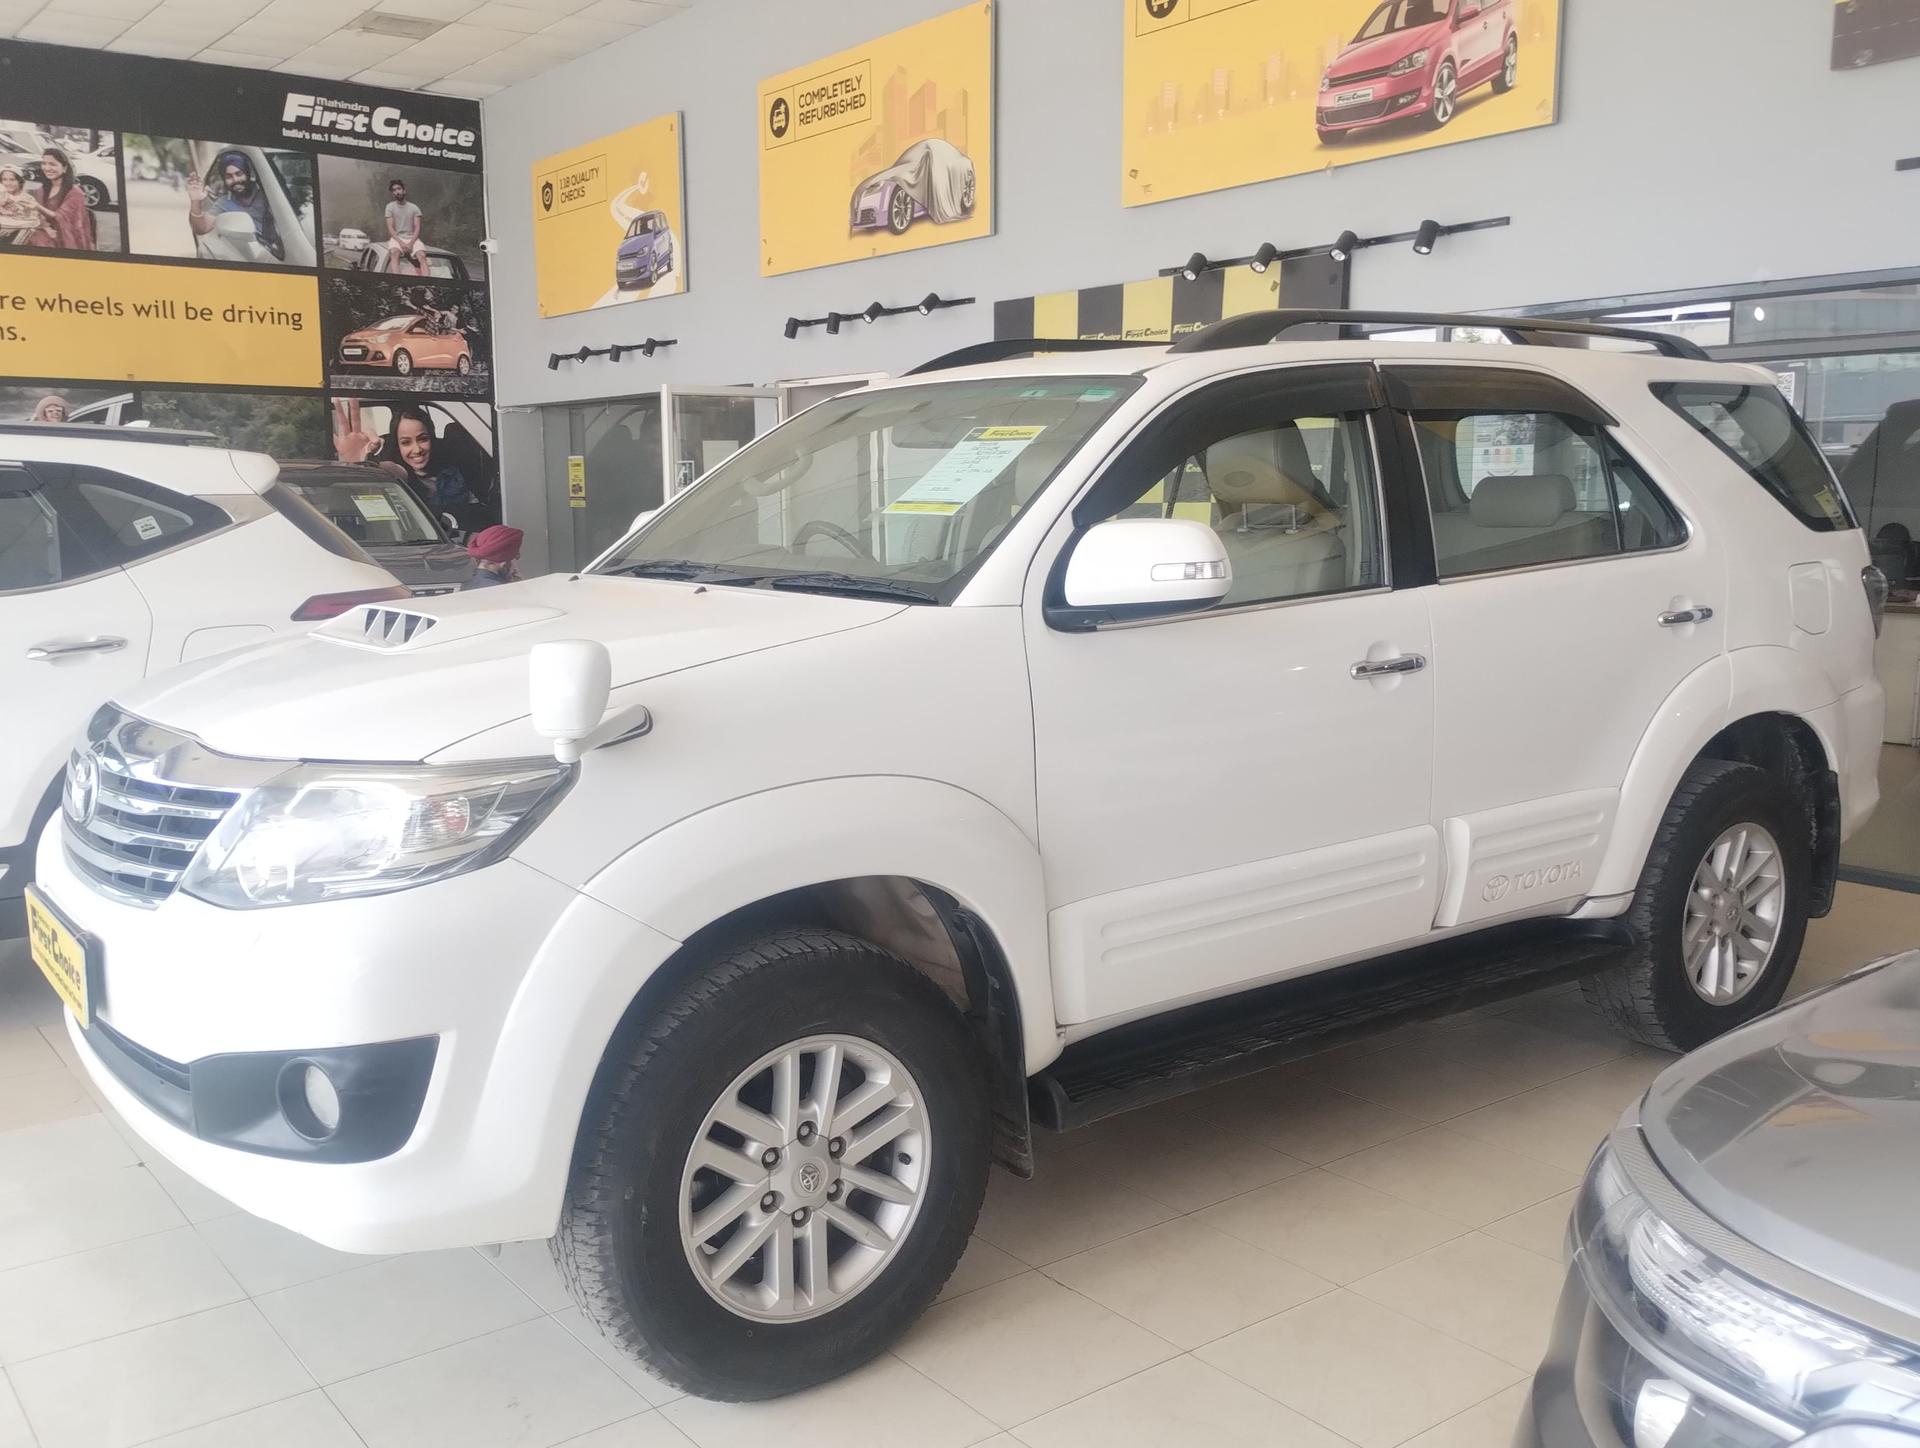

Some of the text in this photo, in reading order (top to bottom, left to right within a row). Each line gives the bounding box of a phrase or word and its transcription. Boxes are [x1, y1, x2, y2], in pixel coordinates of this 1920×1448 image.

[316, 96, 370, 113] Mahindra
[798, 74, 863, 109] COMPLETELY
[282, 92, 475, 147] First Choice
[798, 92, 867, 127] REFURBISHED
[428, 147, 441, 157] Car
[571, 166, 600, 186] QUALITY
[560, 185, 586, 204] CHECKS
[36, 293, 124, 317] wheels
[132, 299, 176, 320] will
[185, 301, 213, 322] be
[222, 304, 303, 331] driving
[1514, 860, 1582, 891] TOYOTA
